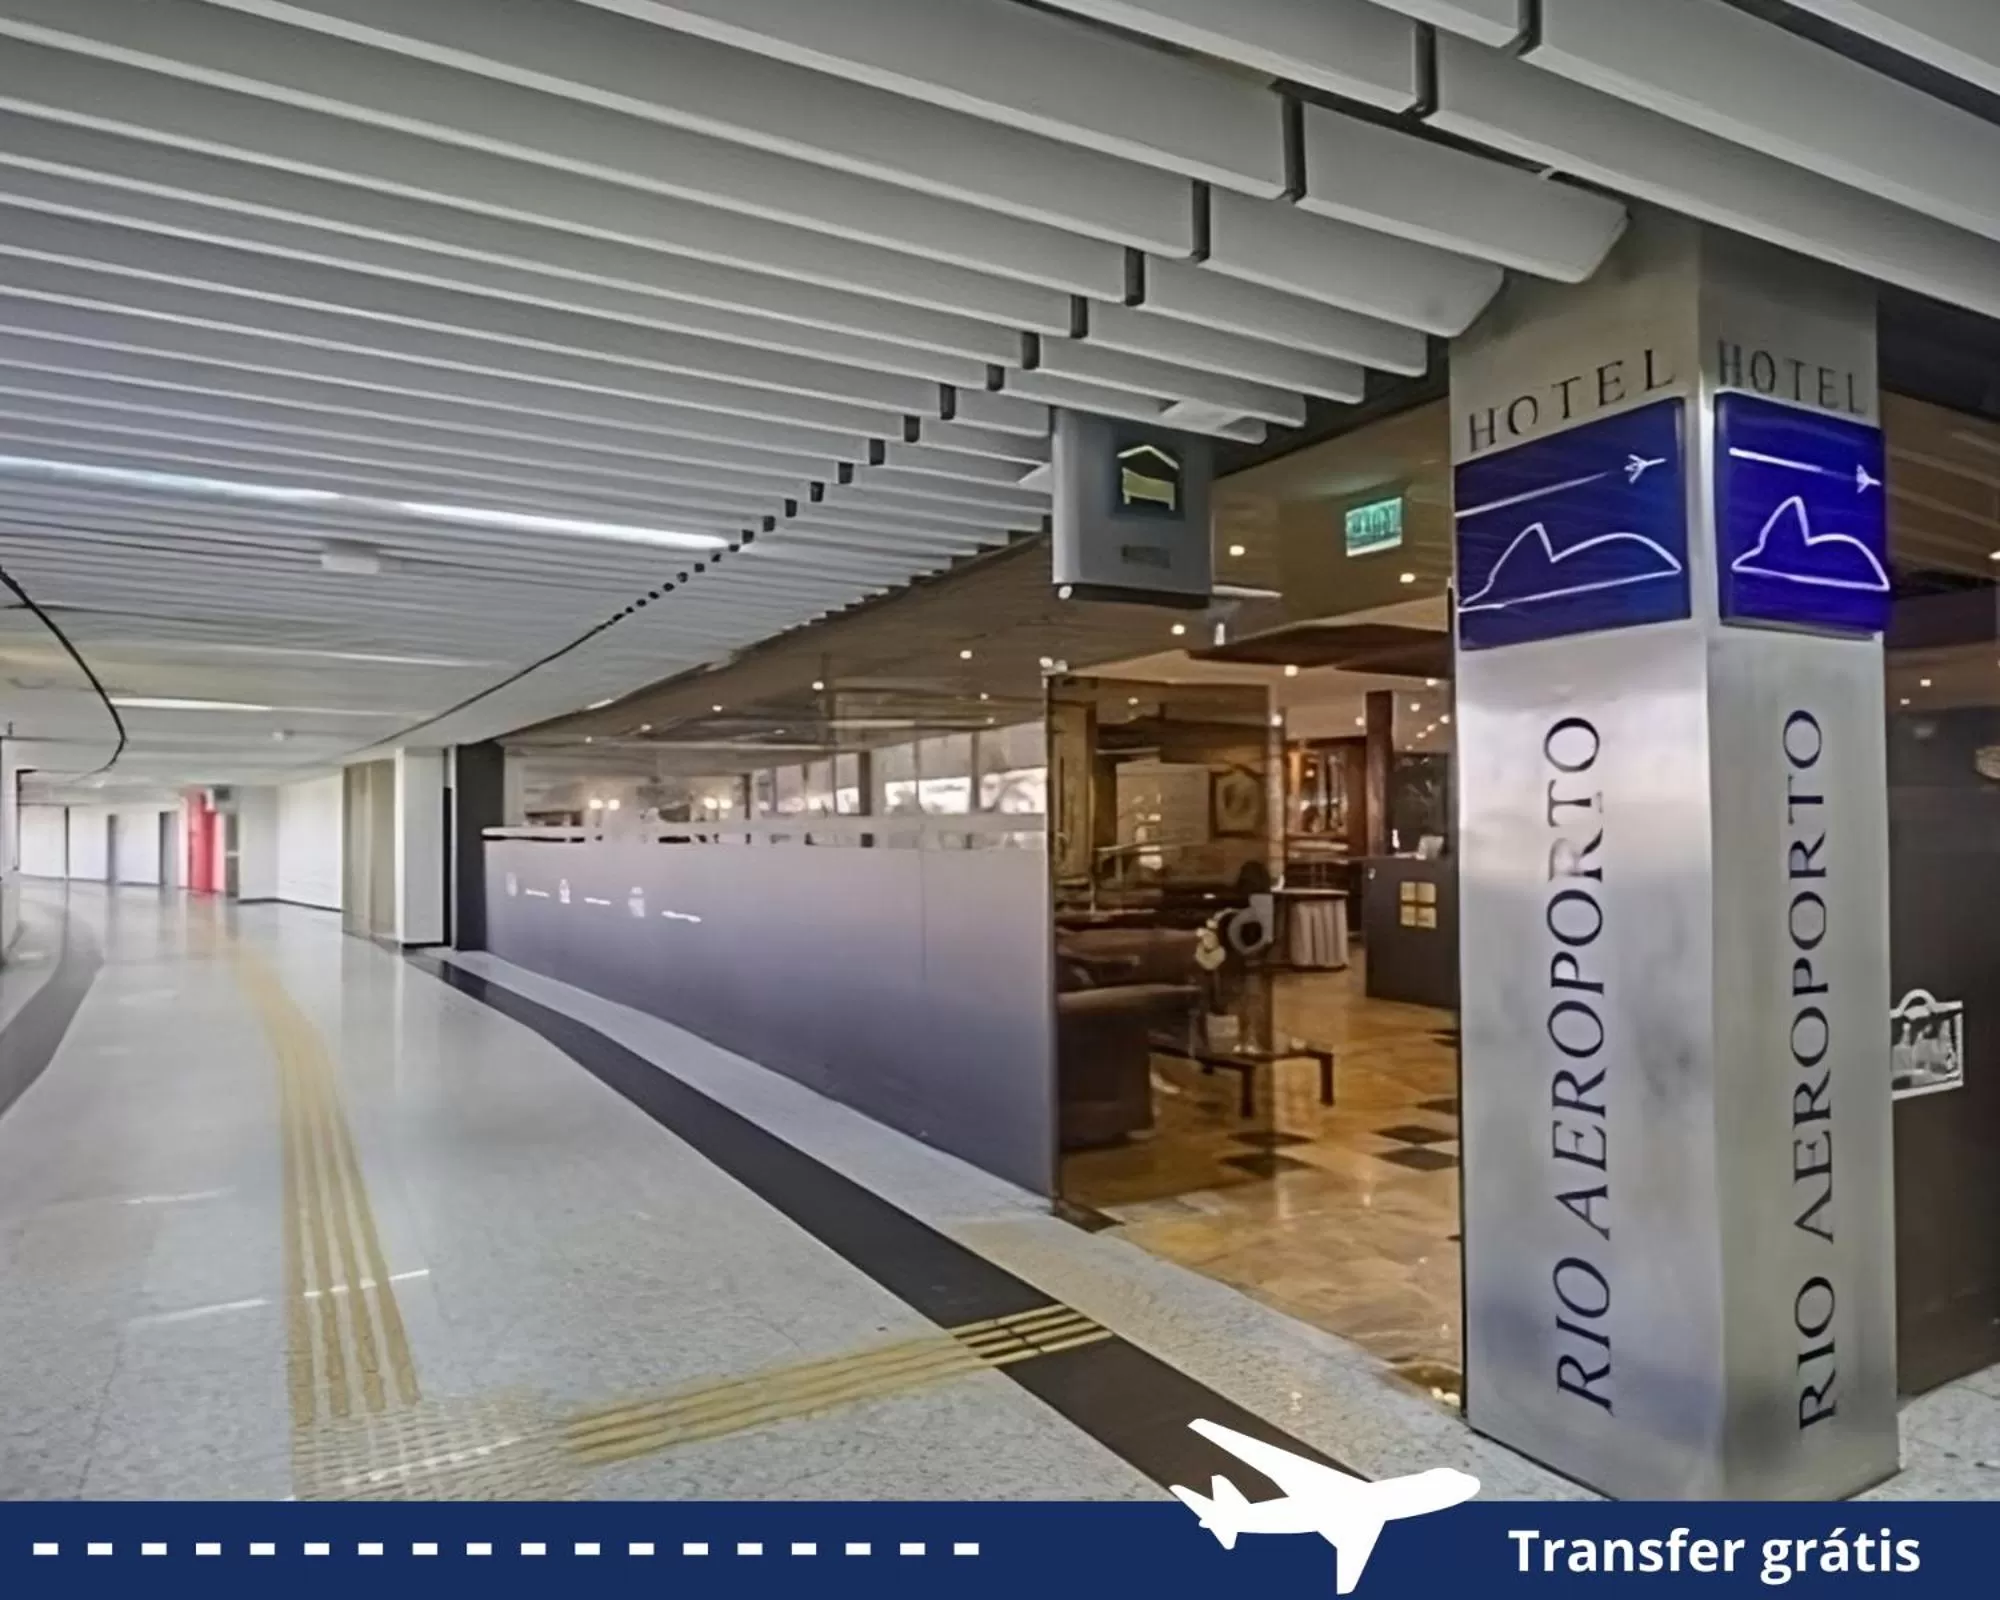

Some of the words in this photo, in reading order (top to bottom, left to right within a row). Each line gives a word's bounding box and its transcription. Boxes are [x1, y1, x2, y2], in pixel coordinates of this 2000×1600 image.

[1469, 349, 1676, 452] HOTEL
[1717, 339, 1867, 416] HOTEL
[1545, 716, 1612, 1241] AEROPORTO
[1783, 709, 1835, 1243] AEROPORTO
[1552, 1255, 1615, 1415] RIO
[1795, 1275, 1837, 1429] RIO
